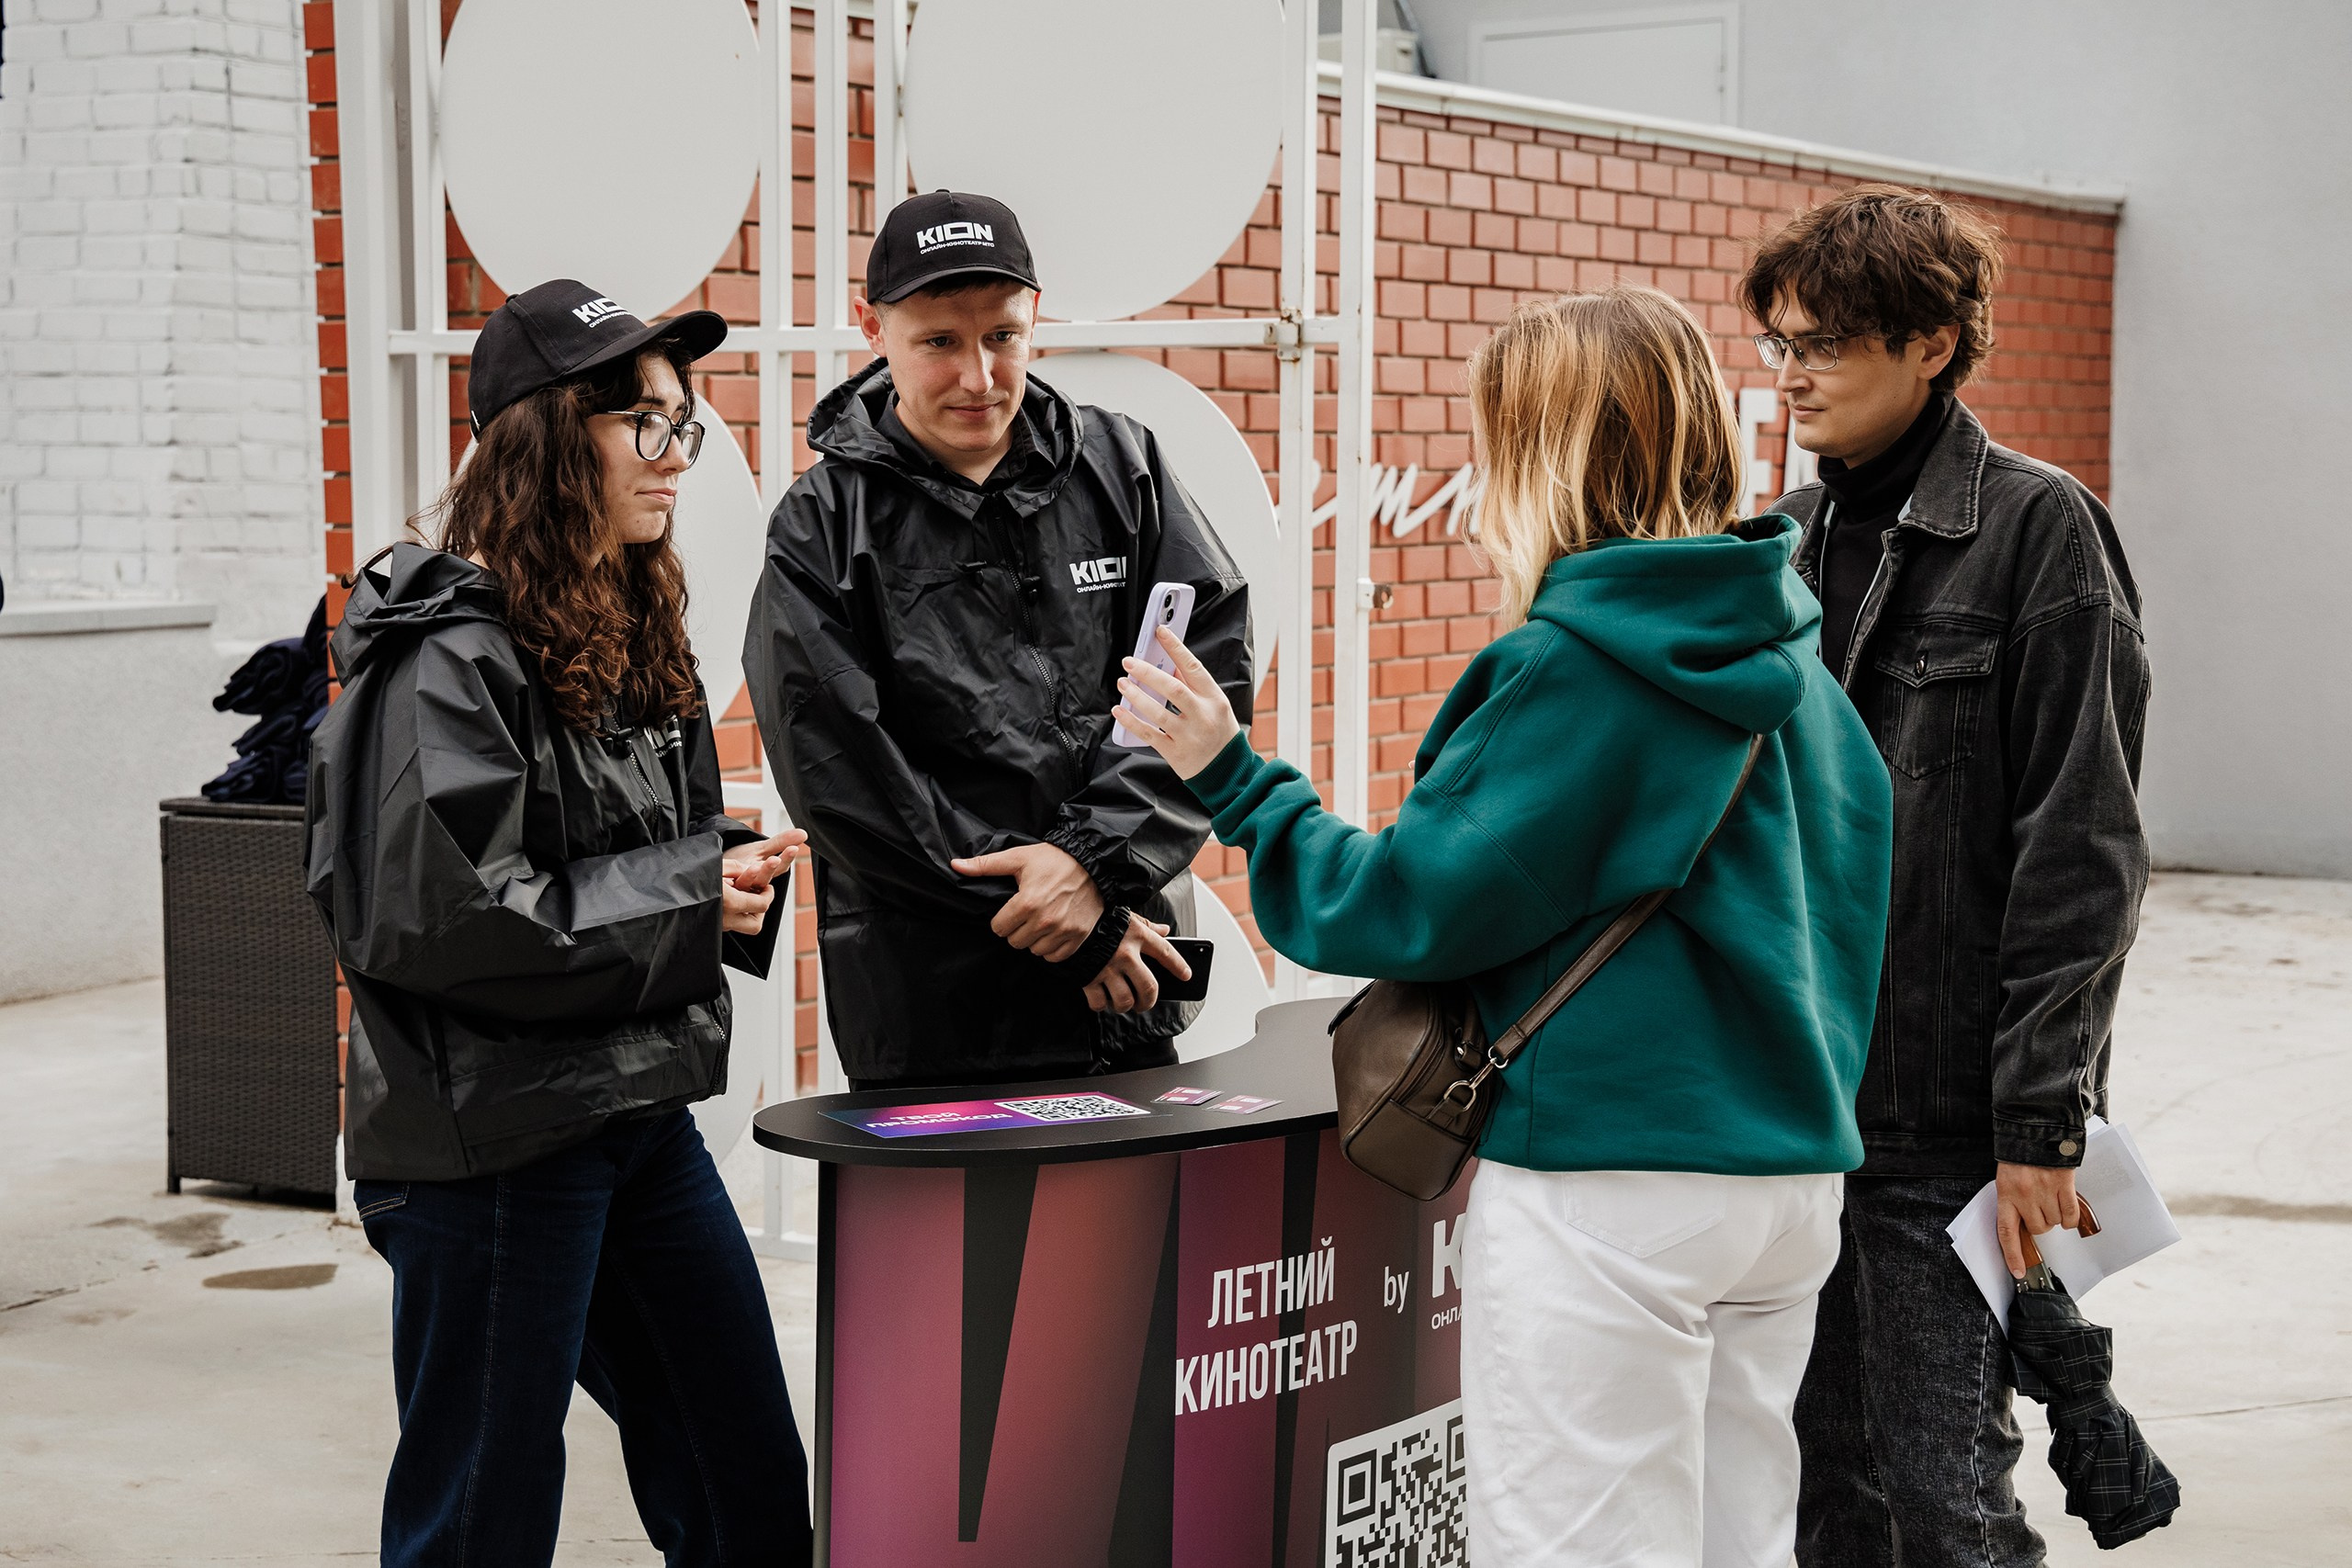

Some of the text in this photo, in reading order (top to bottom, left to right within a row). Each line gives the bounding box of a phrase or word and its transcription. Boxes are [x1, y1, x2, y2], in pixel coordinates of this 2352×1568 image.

[916, 221, 994, 248] KION
[571, 298, 628, 323] KIO
[866, 1112, 1013, 1128] ПРОМОКОД
[889, 1111, 961, 1121] ТВОЙ
[1383, 1213, 1466, 1314] by K
[1207, 1235, 1335, 1329] ЛЕТНИЙ
[1175, 1320, 1358, 1416] КИНОТЕАТР
